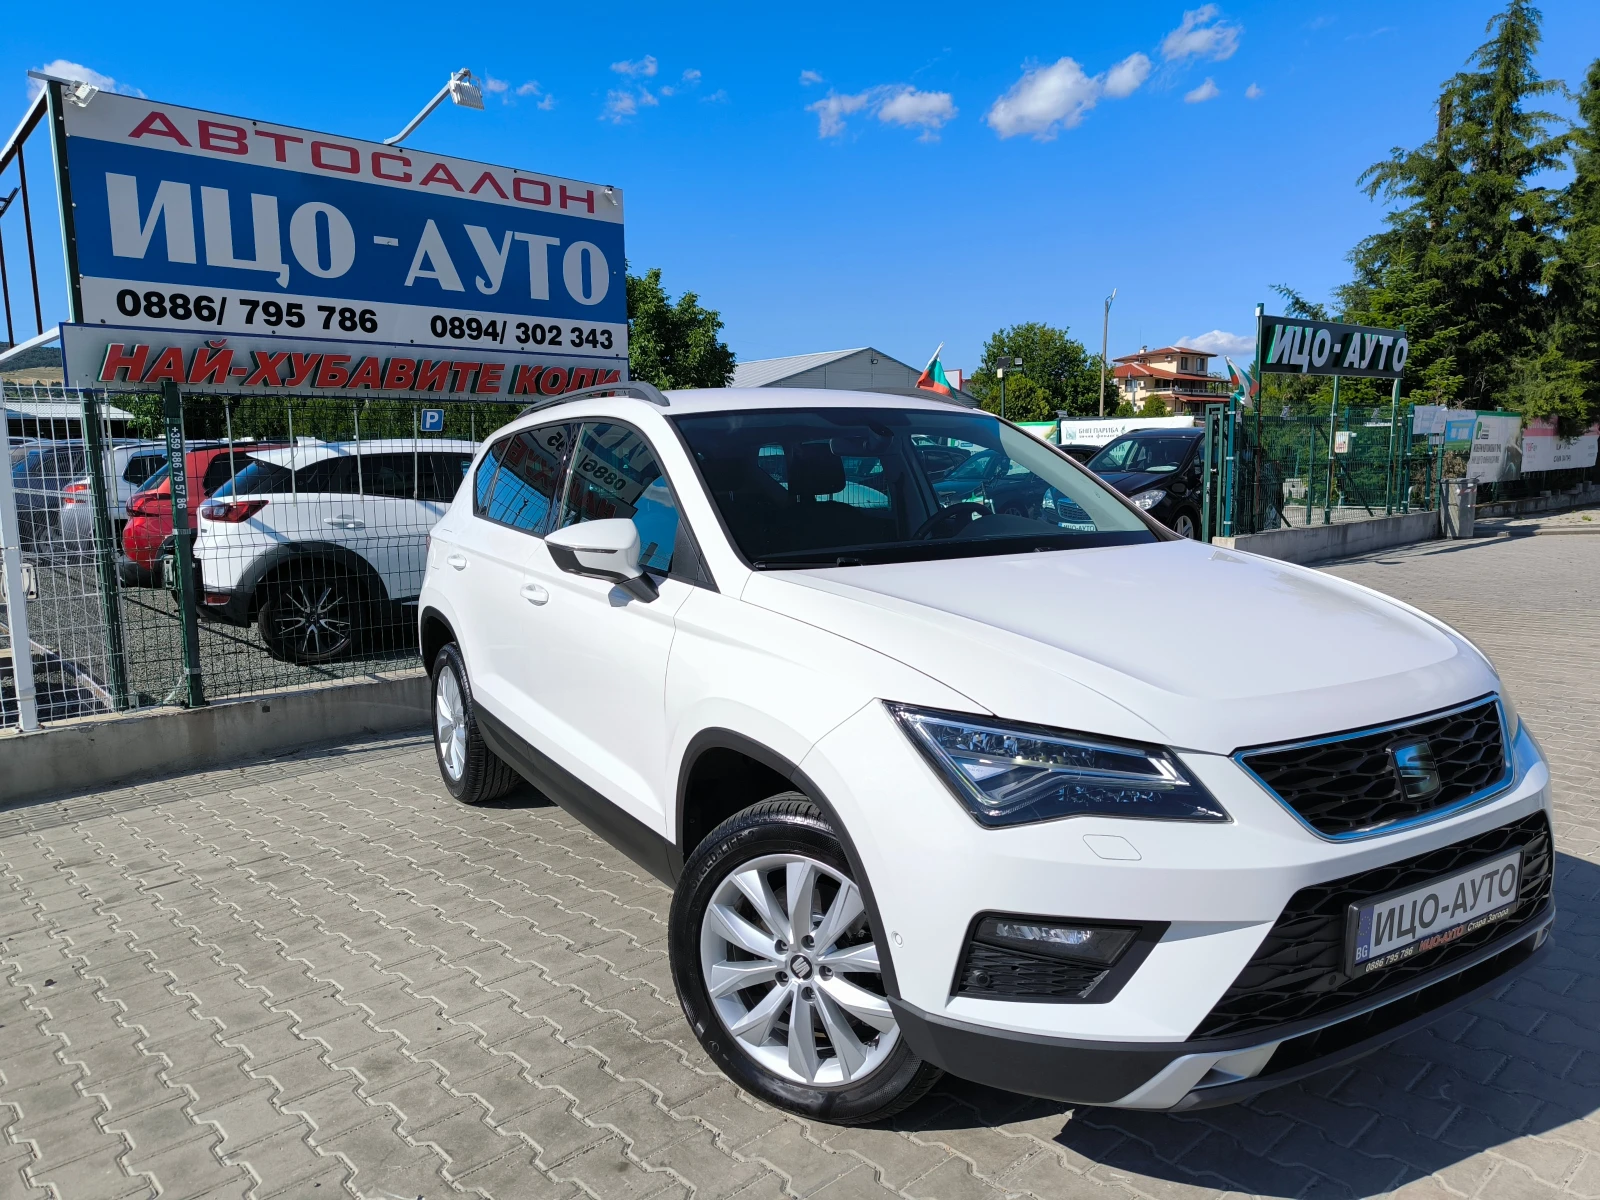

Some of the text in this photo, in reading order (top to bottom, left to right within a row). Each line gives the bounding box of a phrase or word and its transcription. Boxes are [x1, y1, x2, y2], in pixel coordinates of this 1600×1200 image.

[128, 111, 595, 214] АВТОСАЛОН
[116, 288, 378, 333] 0886/ 795 786
[430, 315, 614, 350] 0894/ 302 343
[99, 338, 505, 395] НАЙ-ХУБАВИТЕ
[1269, 324, 1409, 373] ИЦО-АУТО
[425, 411, 439, 429] P
[170, 426, 187, 509] +359 886 79 57 86
[1373, 863, 1516, 947] ИЦО-АУТО
[1356, 945, 1368, 960] BG
[1365, 957, 1384, 972] 0886
[1385, 951, 1399, 965] 795
[1400, 946, 1414, 959] 786
[1467, 916, 1487, 932] Стара
[1488, 908, 1509, 923] Загора
